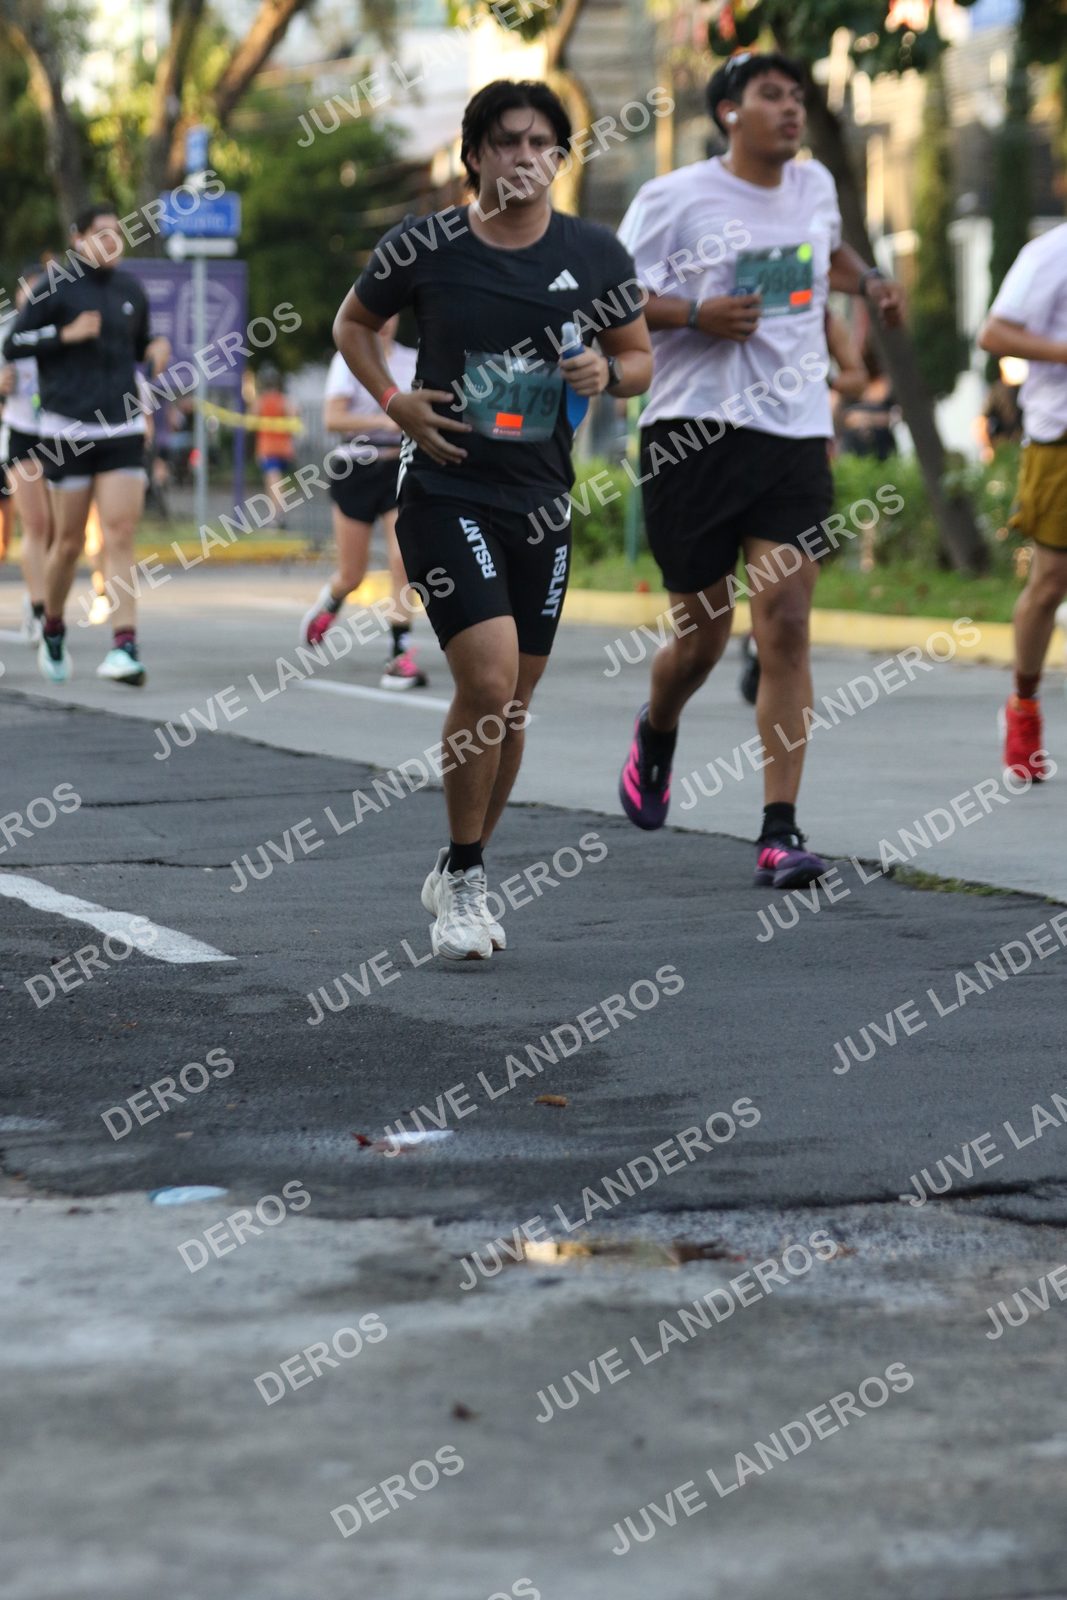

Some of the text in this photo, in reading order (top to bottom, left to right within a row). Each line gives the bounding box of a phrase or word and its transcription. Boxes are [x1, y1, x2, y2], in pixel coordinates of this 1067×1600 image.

[486, 381, 557, 418] 2179
[458, 515, 498, 580] RSLNT
[541, 543, 568, 619] RSLNT
